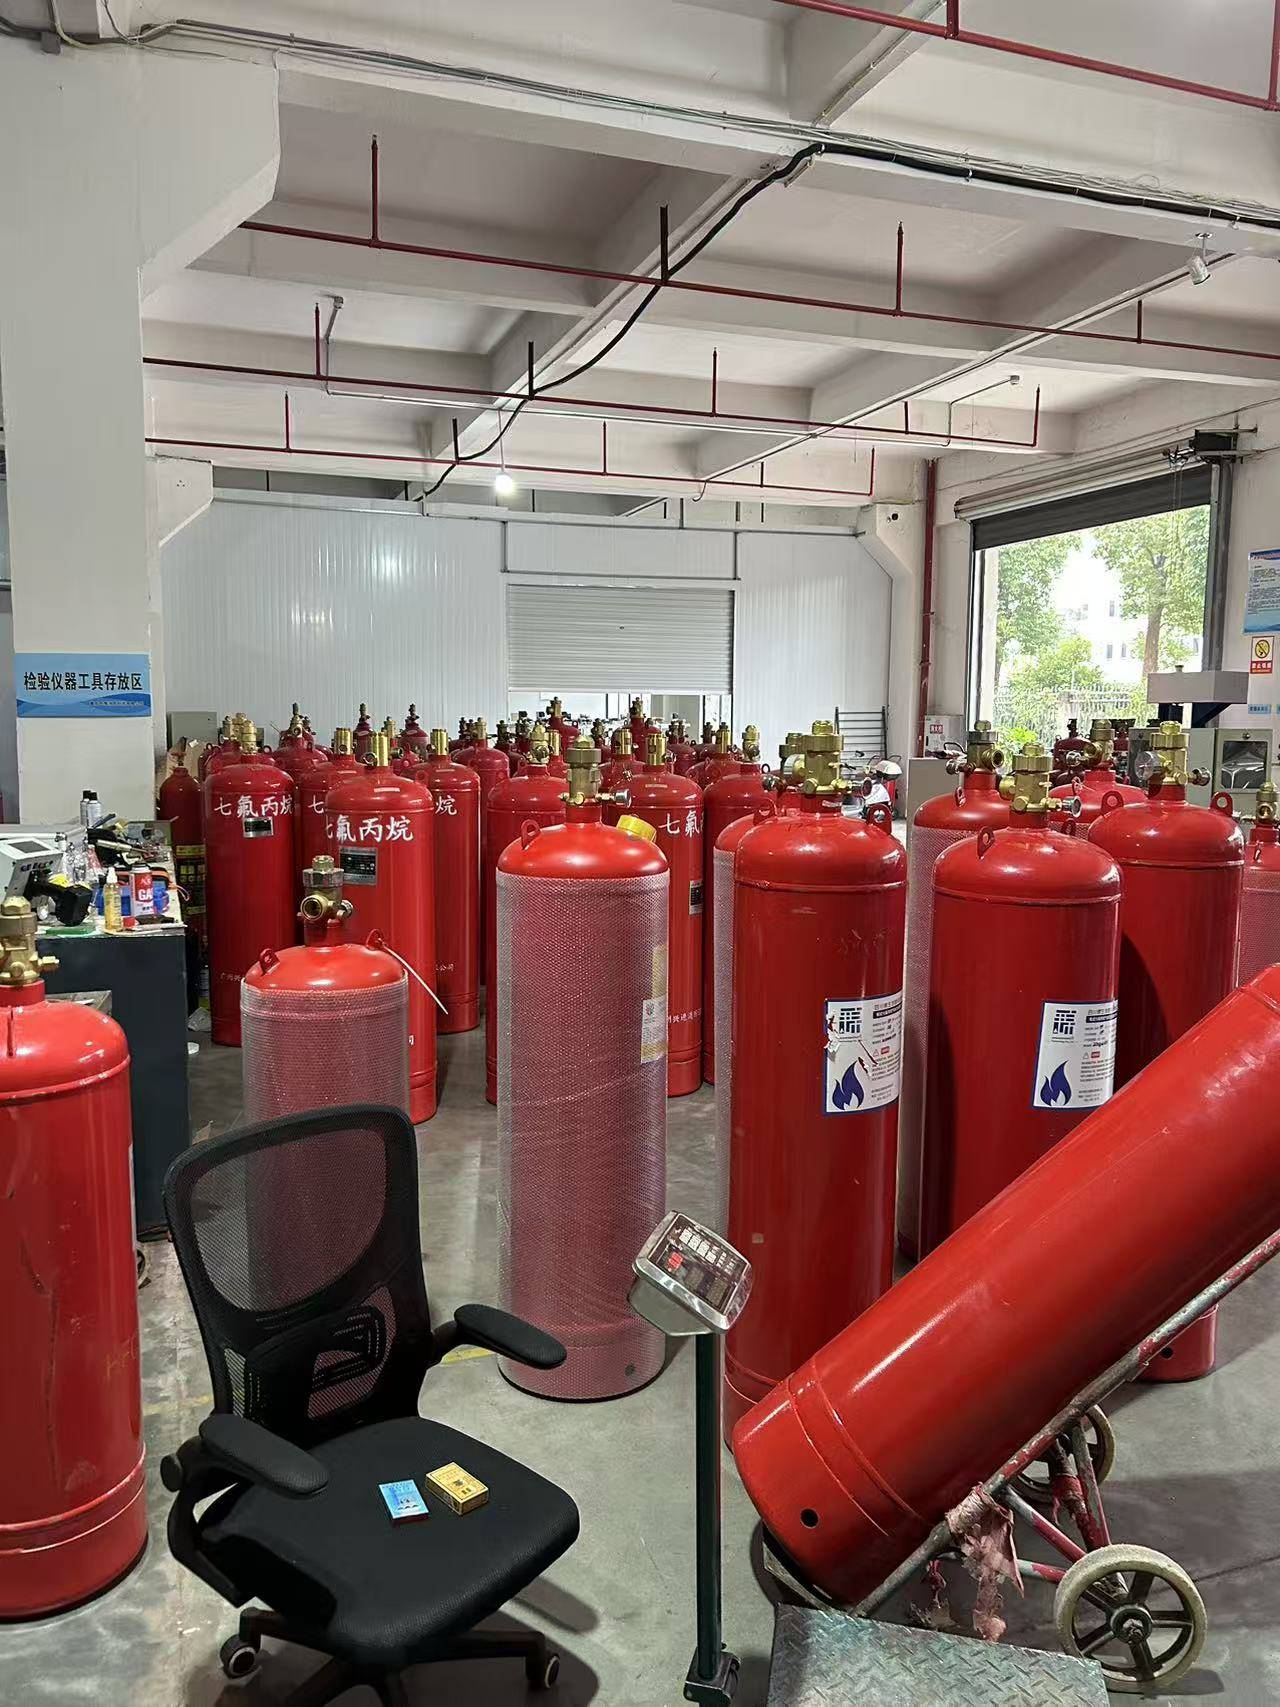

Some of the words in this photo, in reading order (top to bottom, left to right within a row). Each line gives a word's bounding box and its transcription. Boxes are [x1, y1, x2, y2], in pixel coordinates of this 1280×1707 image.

[24, 672, 143, 691] 检验仪器工具存放区
[214, 794, 293, 818] 七氟丙烷
[325, 813, 414, 843] 七氟丙烷
